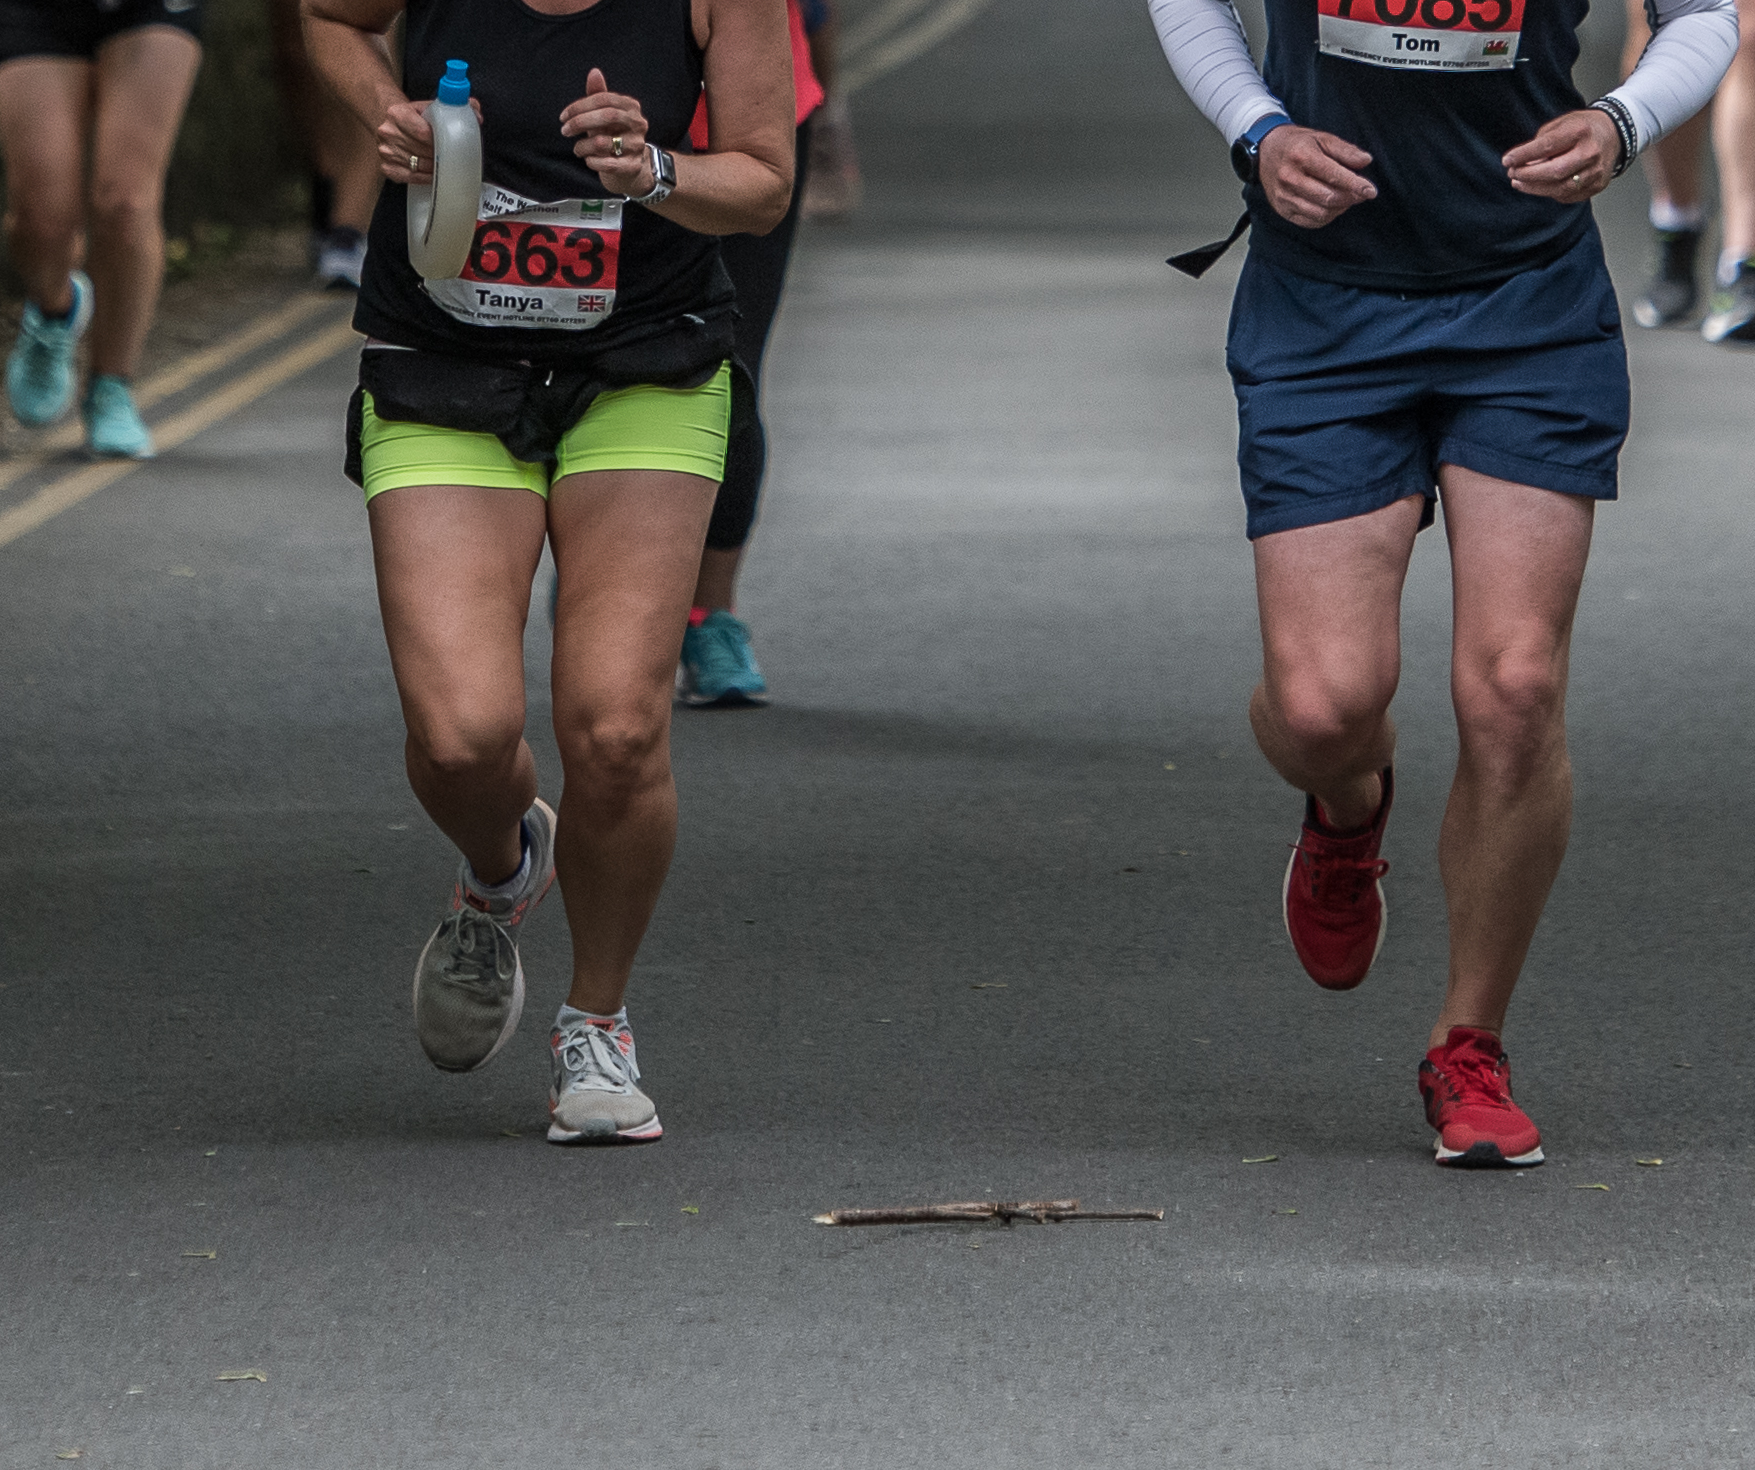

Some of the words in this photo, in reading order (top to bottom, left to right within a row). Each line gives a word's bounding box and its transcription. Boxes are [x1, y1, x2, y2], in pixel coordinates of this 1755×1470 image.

[1392, 33, 1440, 53] Tom
[496, 190, 514, 205] The
[483, 200, 503, 215] Half
[470, 221, 605, 287] 663
[476, 289, 543, 313] Tanya
[477, 312, 501, 321] EVENT
